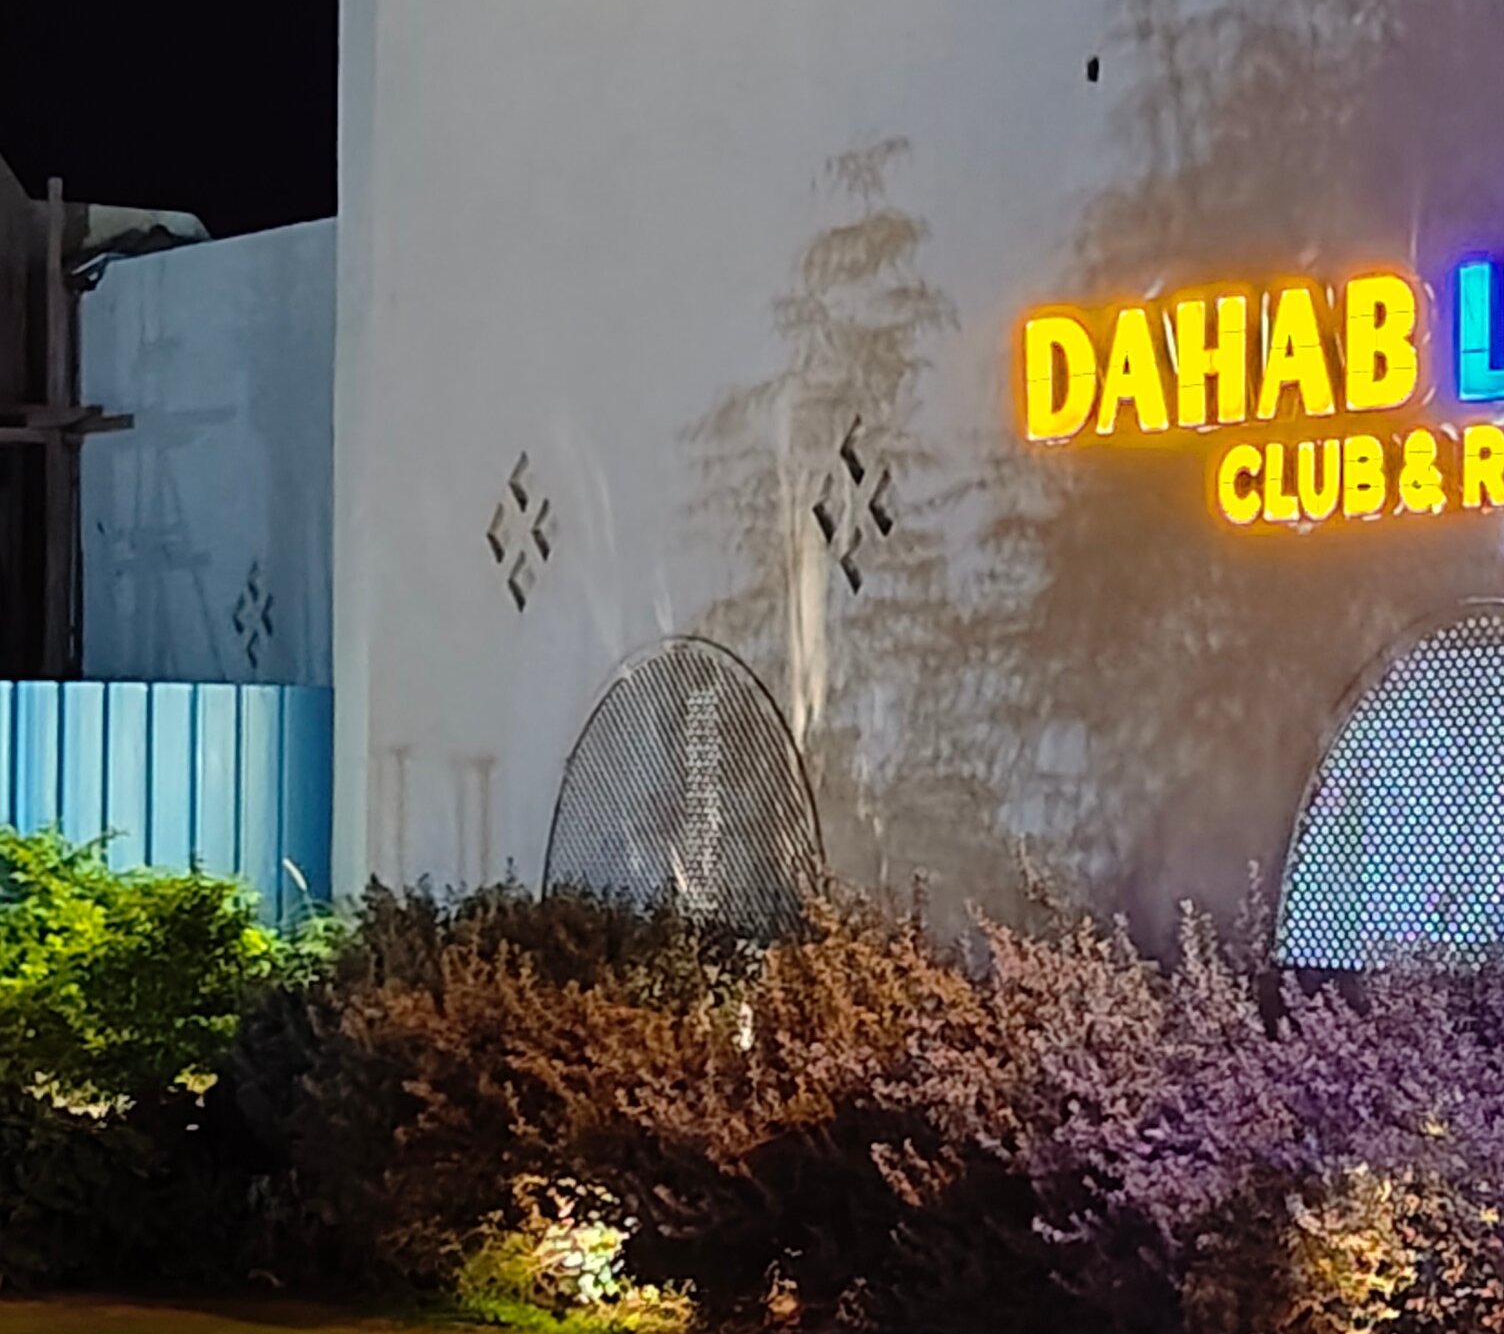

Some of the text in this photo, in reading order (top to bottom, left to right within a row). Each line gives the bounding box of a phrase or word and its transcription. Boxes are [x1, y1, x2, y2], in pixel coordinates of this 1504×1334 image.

[1024, 273, 1418, 442] DAHAB
[1218, 433, 1385, 524] CLUB
[1397, 427, 1445, 514] &
